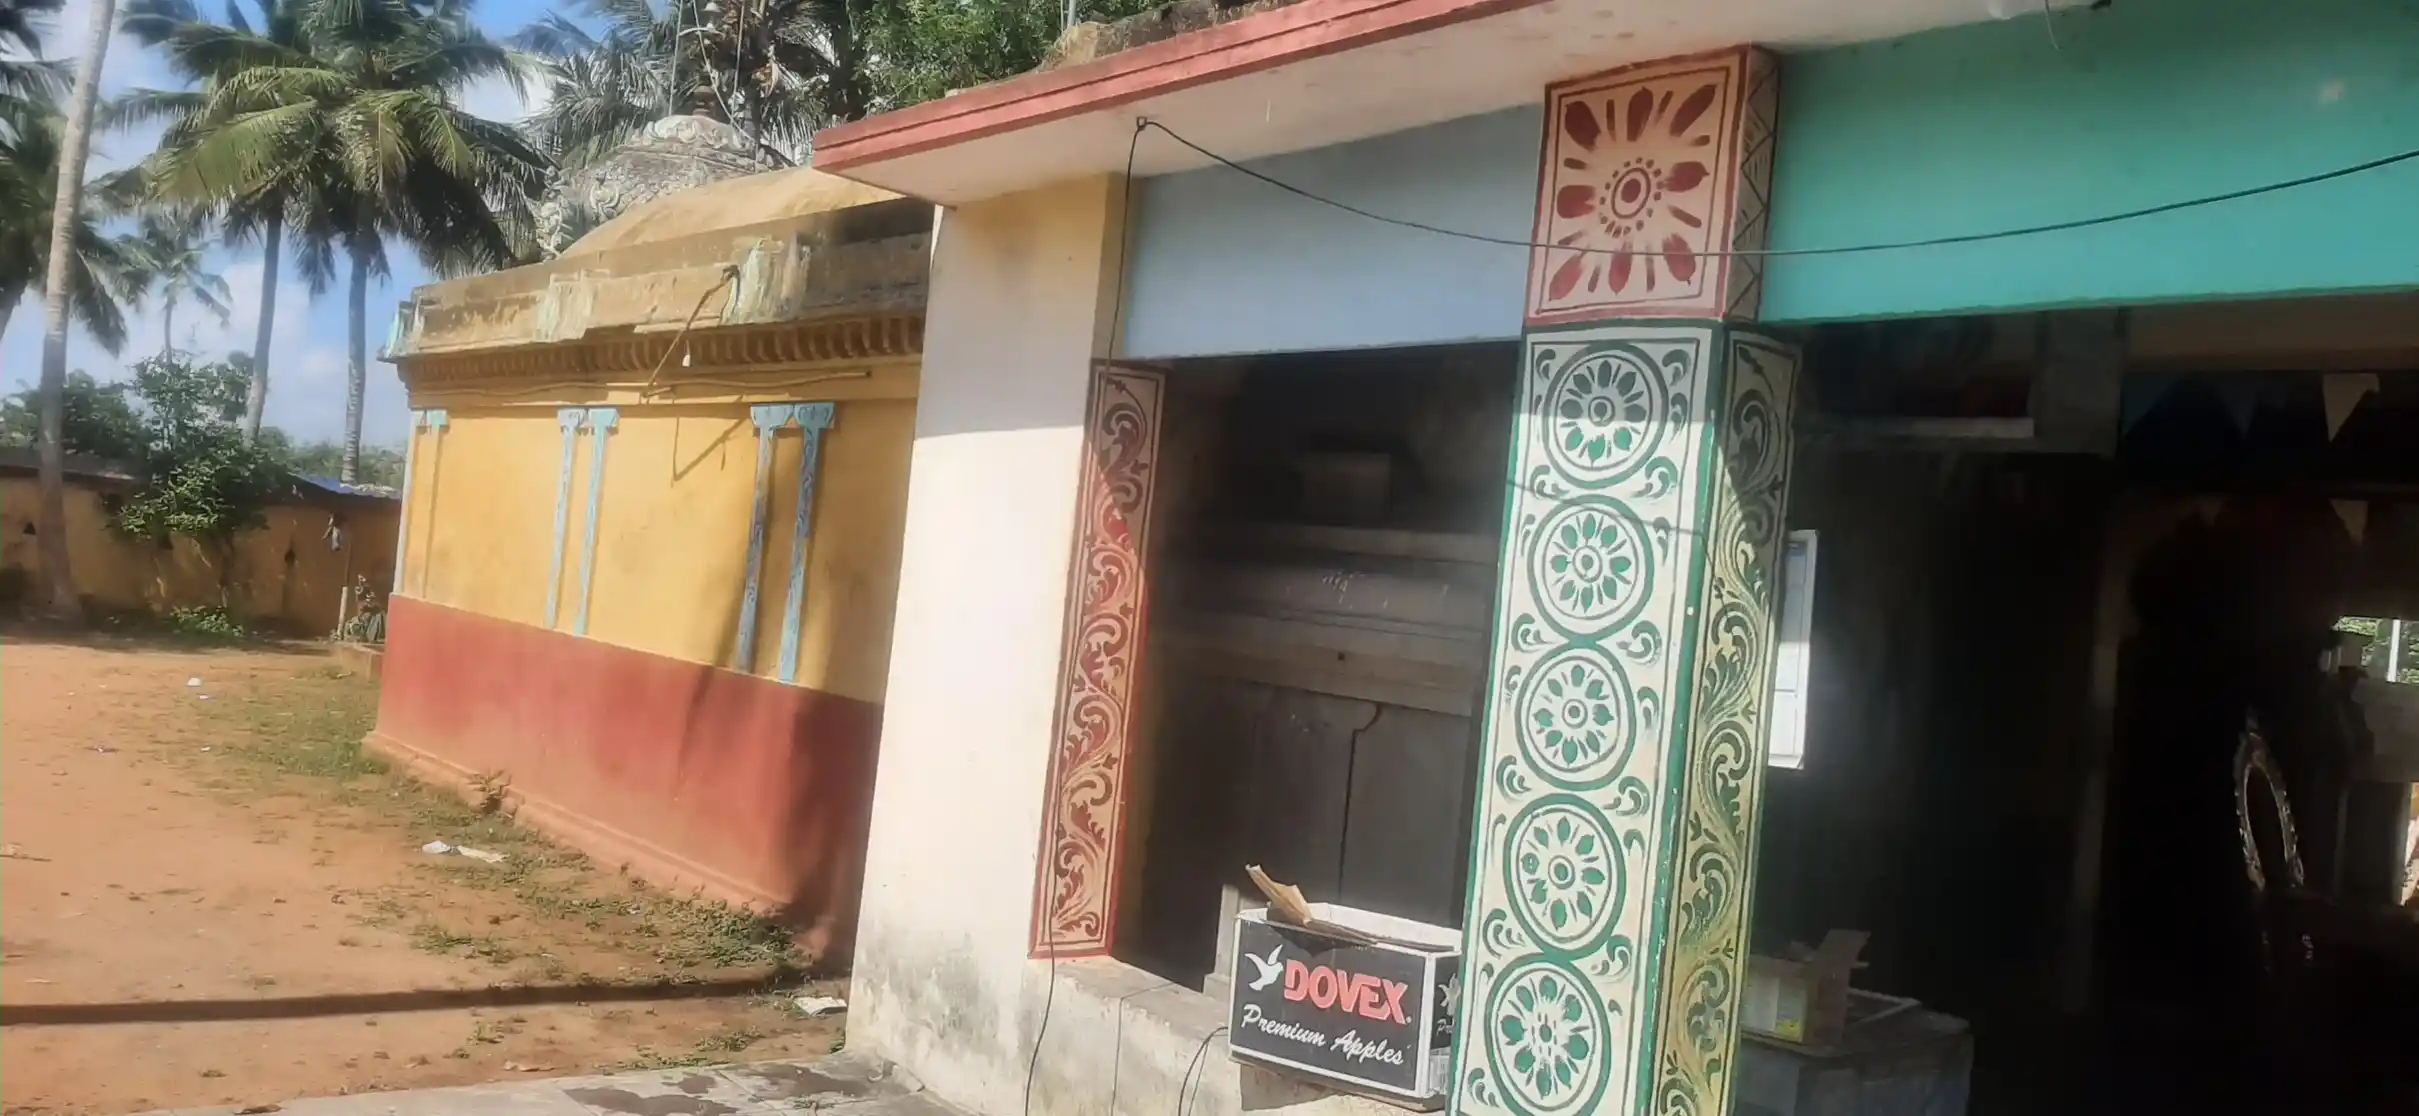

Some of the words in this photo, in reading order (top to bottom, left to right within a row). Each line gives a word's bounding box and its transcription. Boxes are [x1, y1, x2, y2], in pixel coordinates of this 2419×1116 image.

[1284, 959, 1408, 1024] DOVEX
[1241, 1004, 1326, 1047] Premium
[1330, 1029, 1404, 1065] Apples
